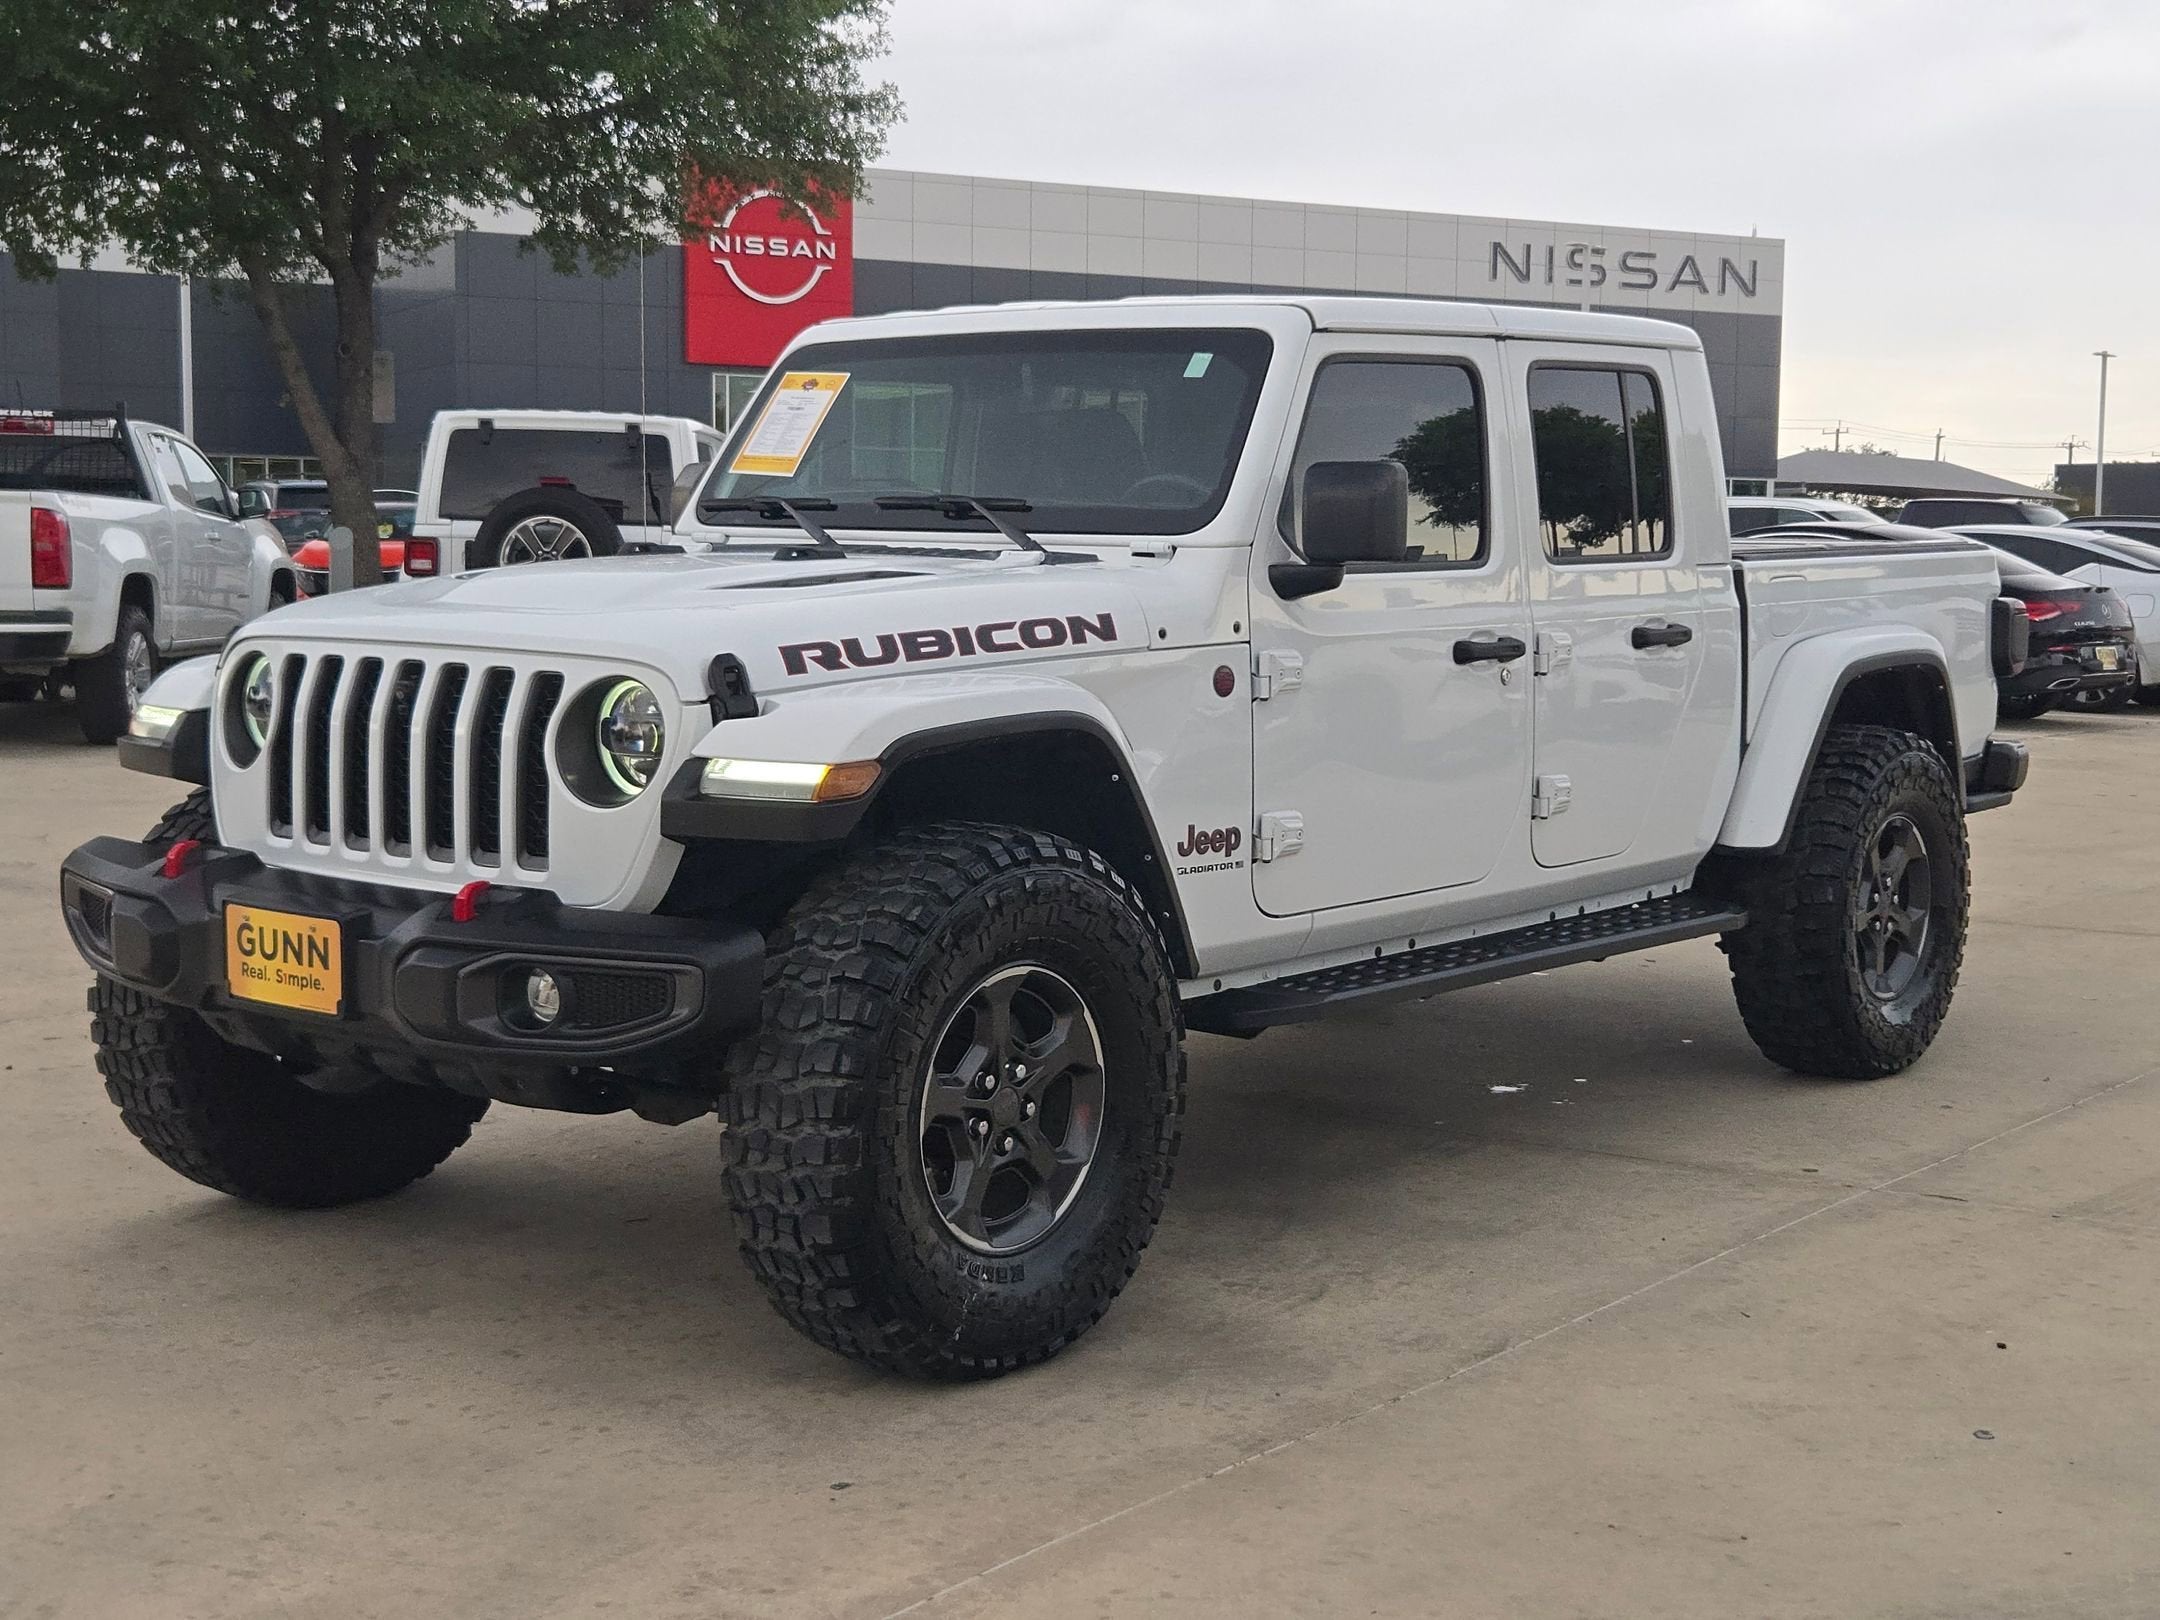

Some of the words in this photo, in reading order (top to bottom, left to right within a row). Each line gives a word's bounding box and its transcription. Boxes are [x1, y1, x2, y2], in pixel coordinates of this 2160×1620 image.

[709, 233, 836, 260] NISSAN
[1488, 241, 1757, 298] NISSAN
[777, 612, 1118, 677] RUBICON
[1177, 824, 1242, 857] Jeep
[1177, 862, 1234, 876] GLADIATOR
[236, 922, 330, 970] GUNN
[241, 961, 271, 982] Real.
